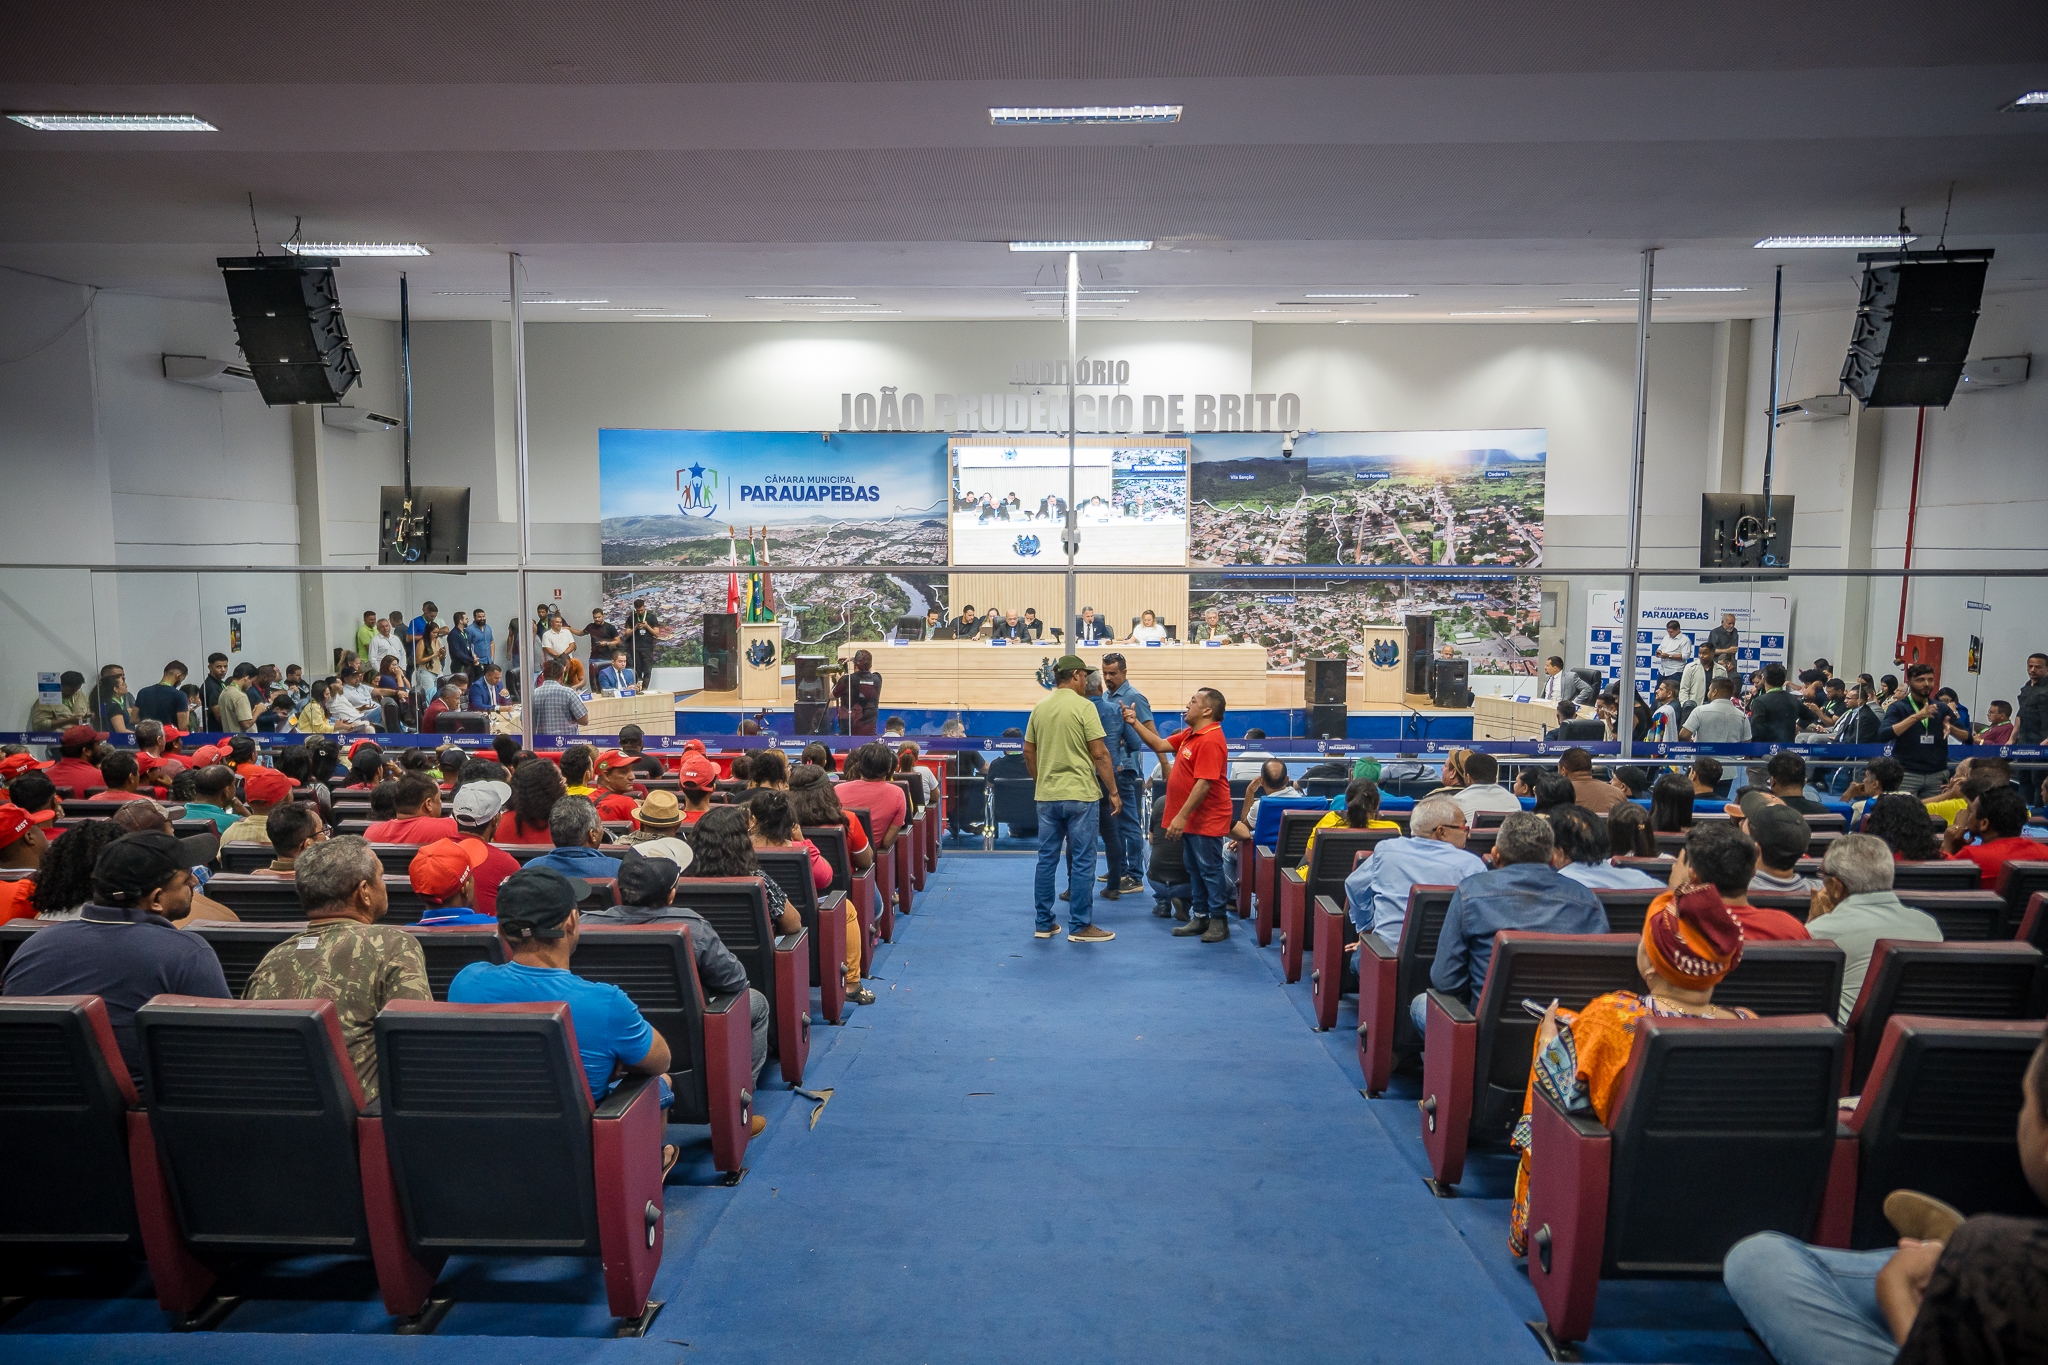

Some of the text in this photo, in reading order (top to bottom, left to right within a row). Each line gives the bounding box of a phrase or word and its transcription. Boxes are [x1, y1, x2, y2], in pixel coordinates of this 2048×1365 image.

[1010, 355, 1130, 385] AUDITÓRIO
[839, 386, 1301, 432] JOÃO PRUDÊNCIO DE BRITO
[765, 474, 805, 484] CÂMARA
[740, 485, 880, 502] PARAUAPEBAS
[1642, 610, 1709, 620] PARAUAPEBAS
[16, 764, 28, 772] MST
[15, 819, 28, 832] MST
[460, 865, 470, 883] MST
